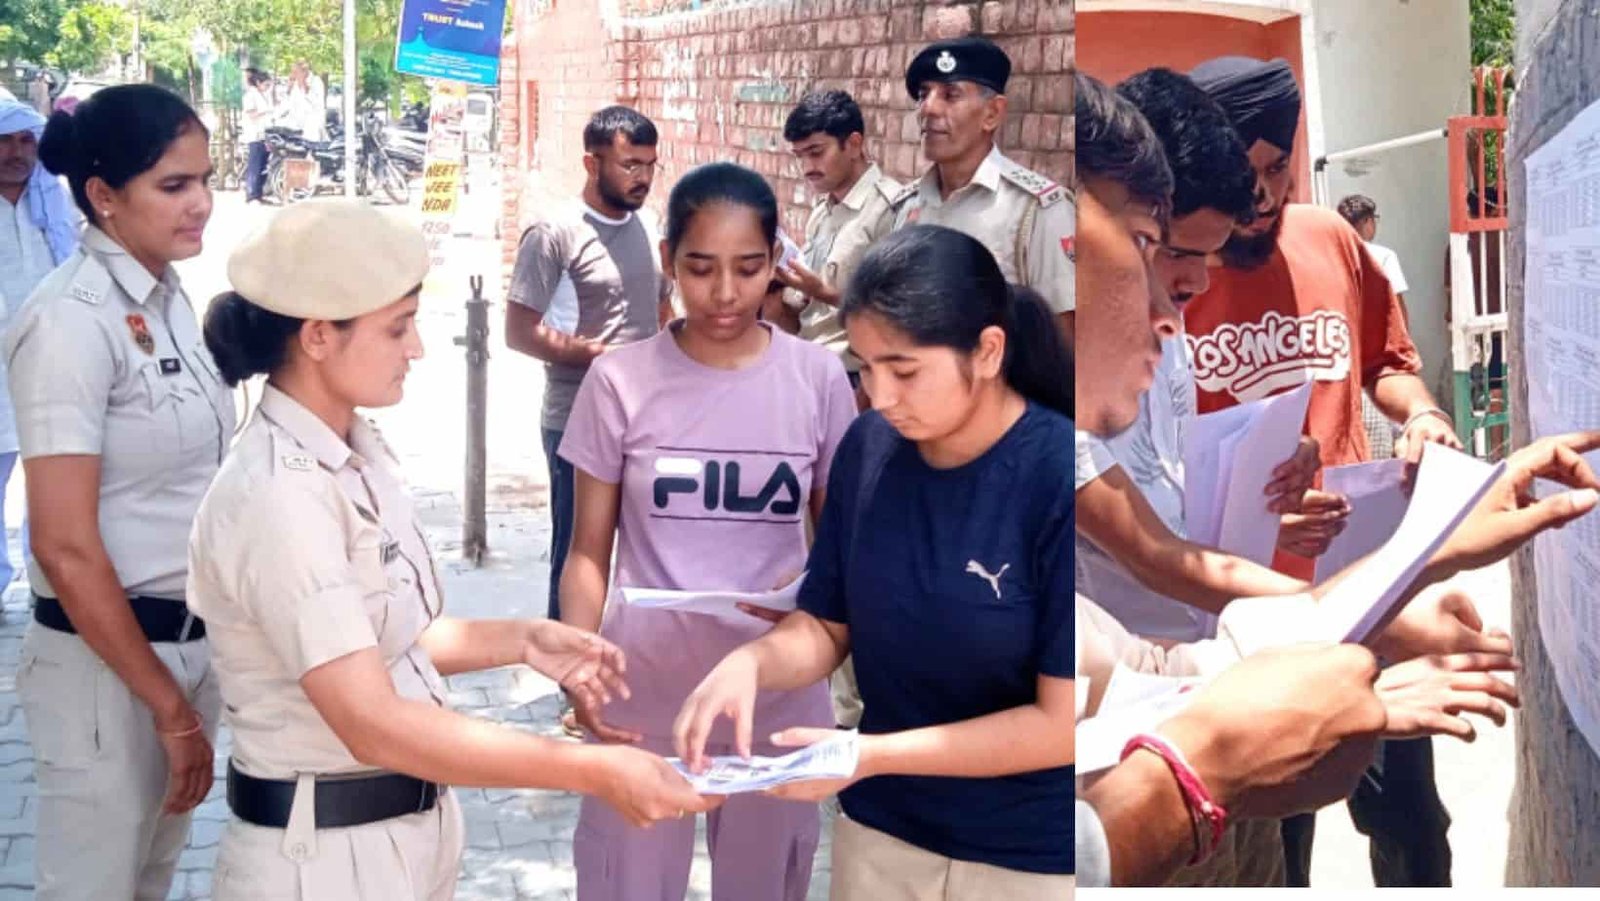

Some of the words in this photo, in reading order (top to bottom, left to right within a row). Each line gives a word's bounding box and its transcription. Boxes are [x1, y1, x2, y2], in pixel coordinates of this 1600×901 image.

[425, 163, 456, 178] NEET
[425, 181, 453, 194] JEE
[1237, 311, 1350, 370] ANGELES
[653, 457, 801, 514] FILA
